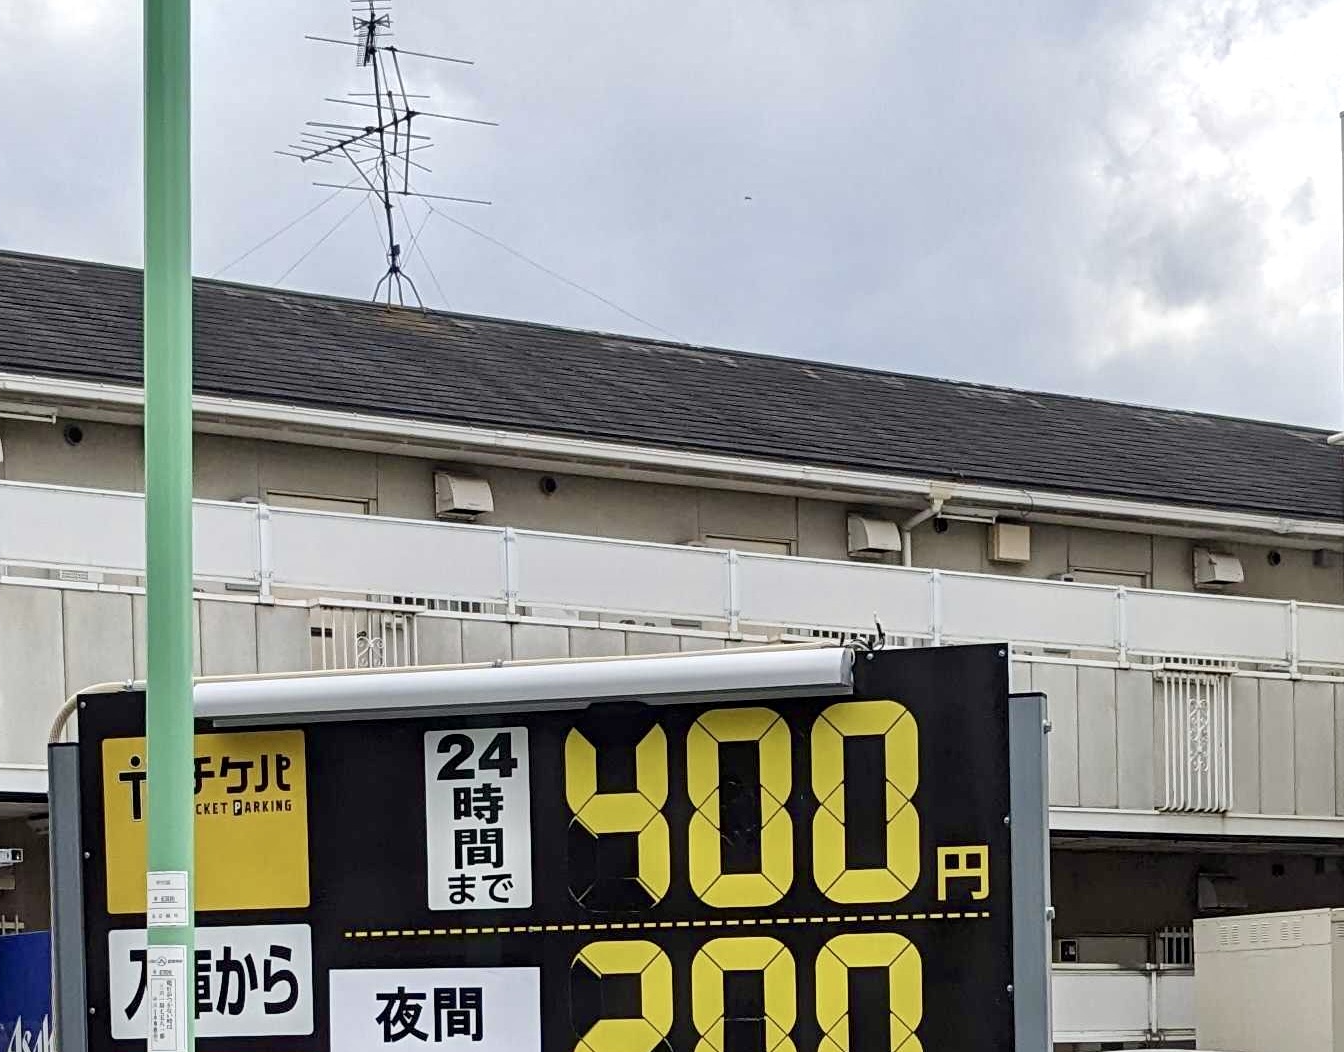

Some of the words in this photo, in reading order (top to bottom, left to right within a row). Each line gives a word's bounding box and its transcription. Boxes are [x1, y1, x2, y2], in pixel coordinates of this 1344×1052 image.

[195, 801, 229, 816] CKET
[232, 799, 293, 816] PARKING
[375, 986, 486, 1043] 夜間
